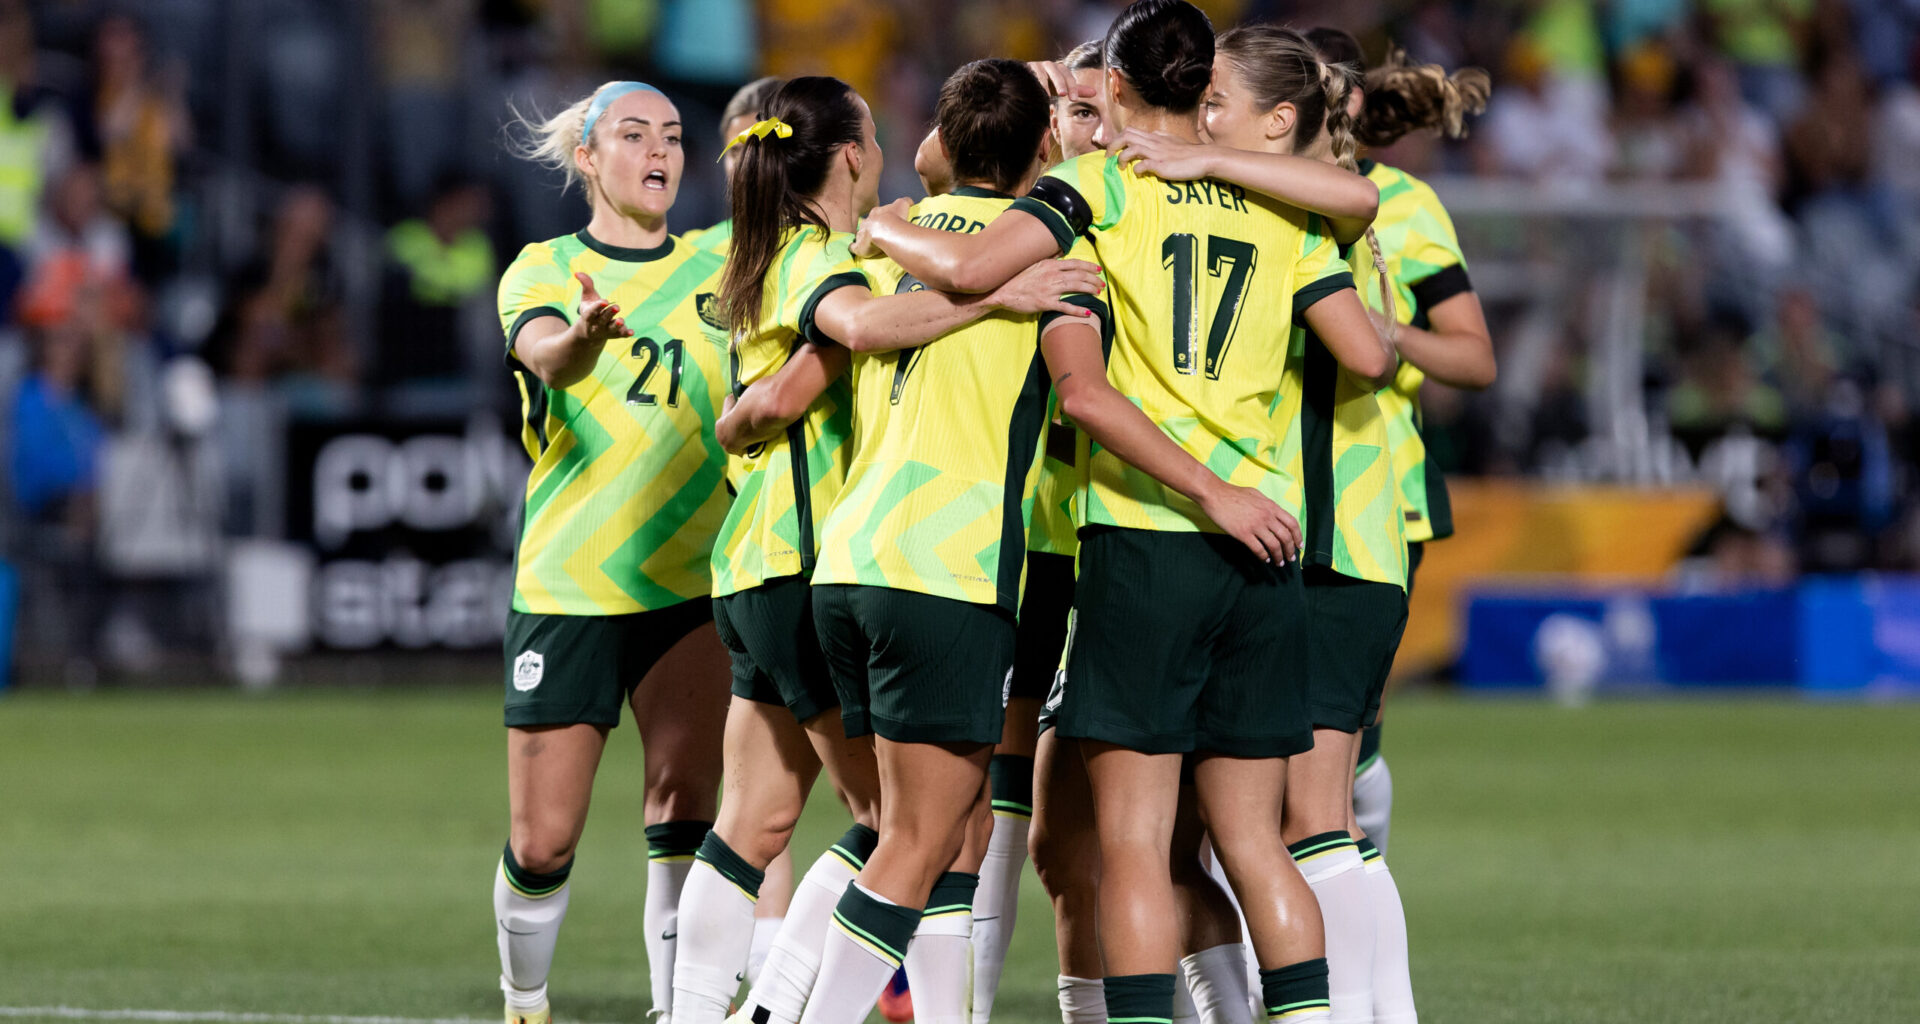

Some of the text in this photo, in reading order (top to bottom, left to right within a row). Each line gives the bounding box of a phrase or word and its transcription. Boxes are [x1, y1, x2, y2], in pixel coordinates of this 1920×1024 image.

[1165, 178, 1249, 214] SAYER
[1161, 232, 1258, 381] 17
[626, 336, 686, 408] 21
